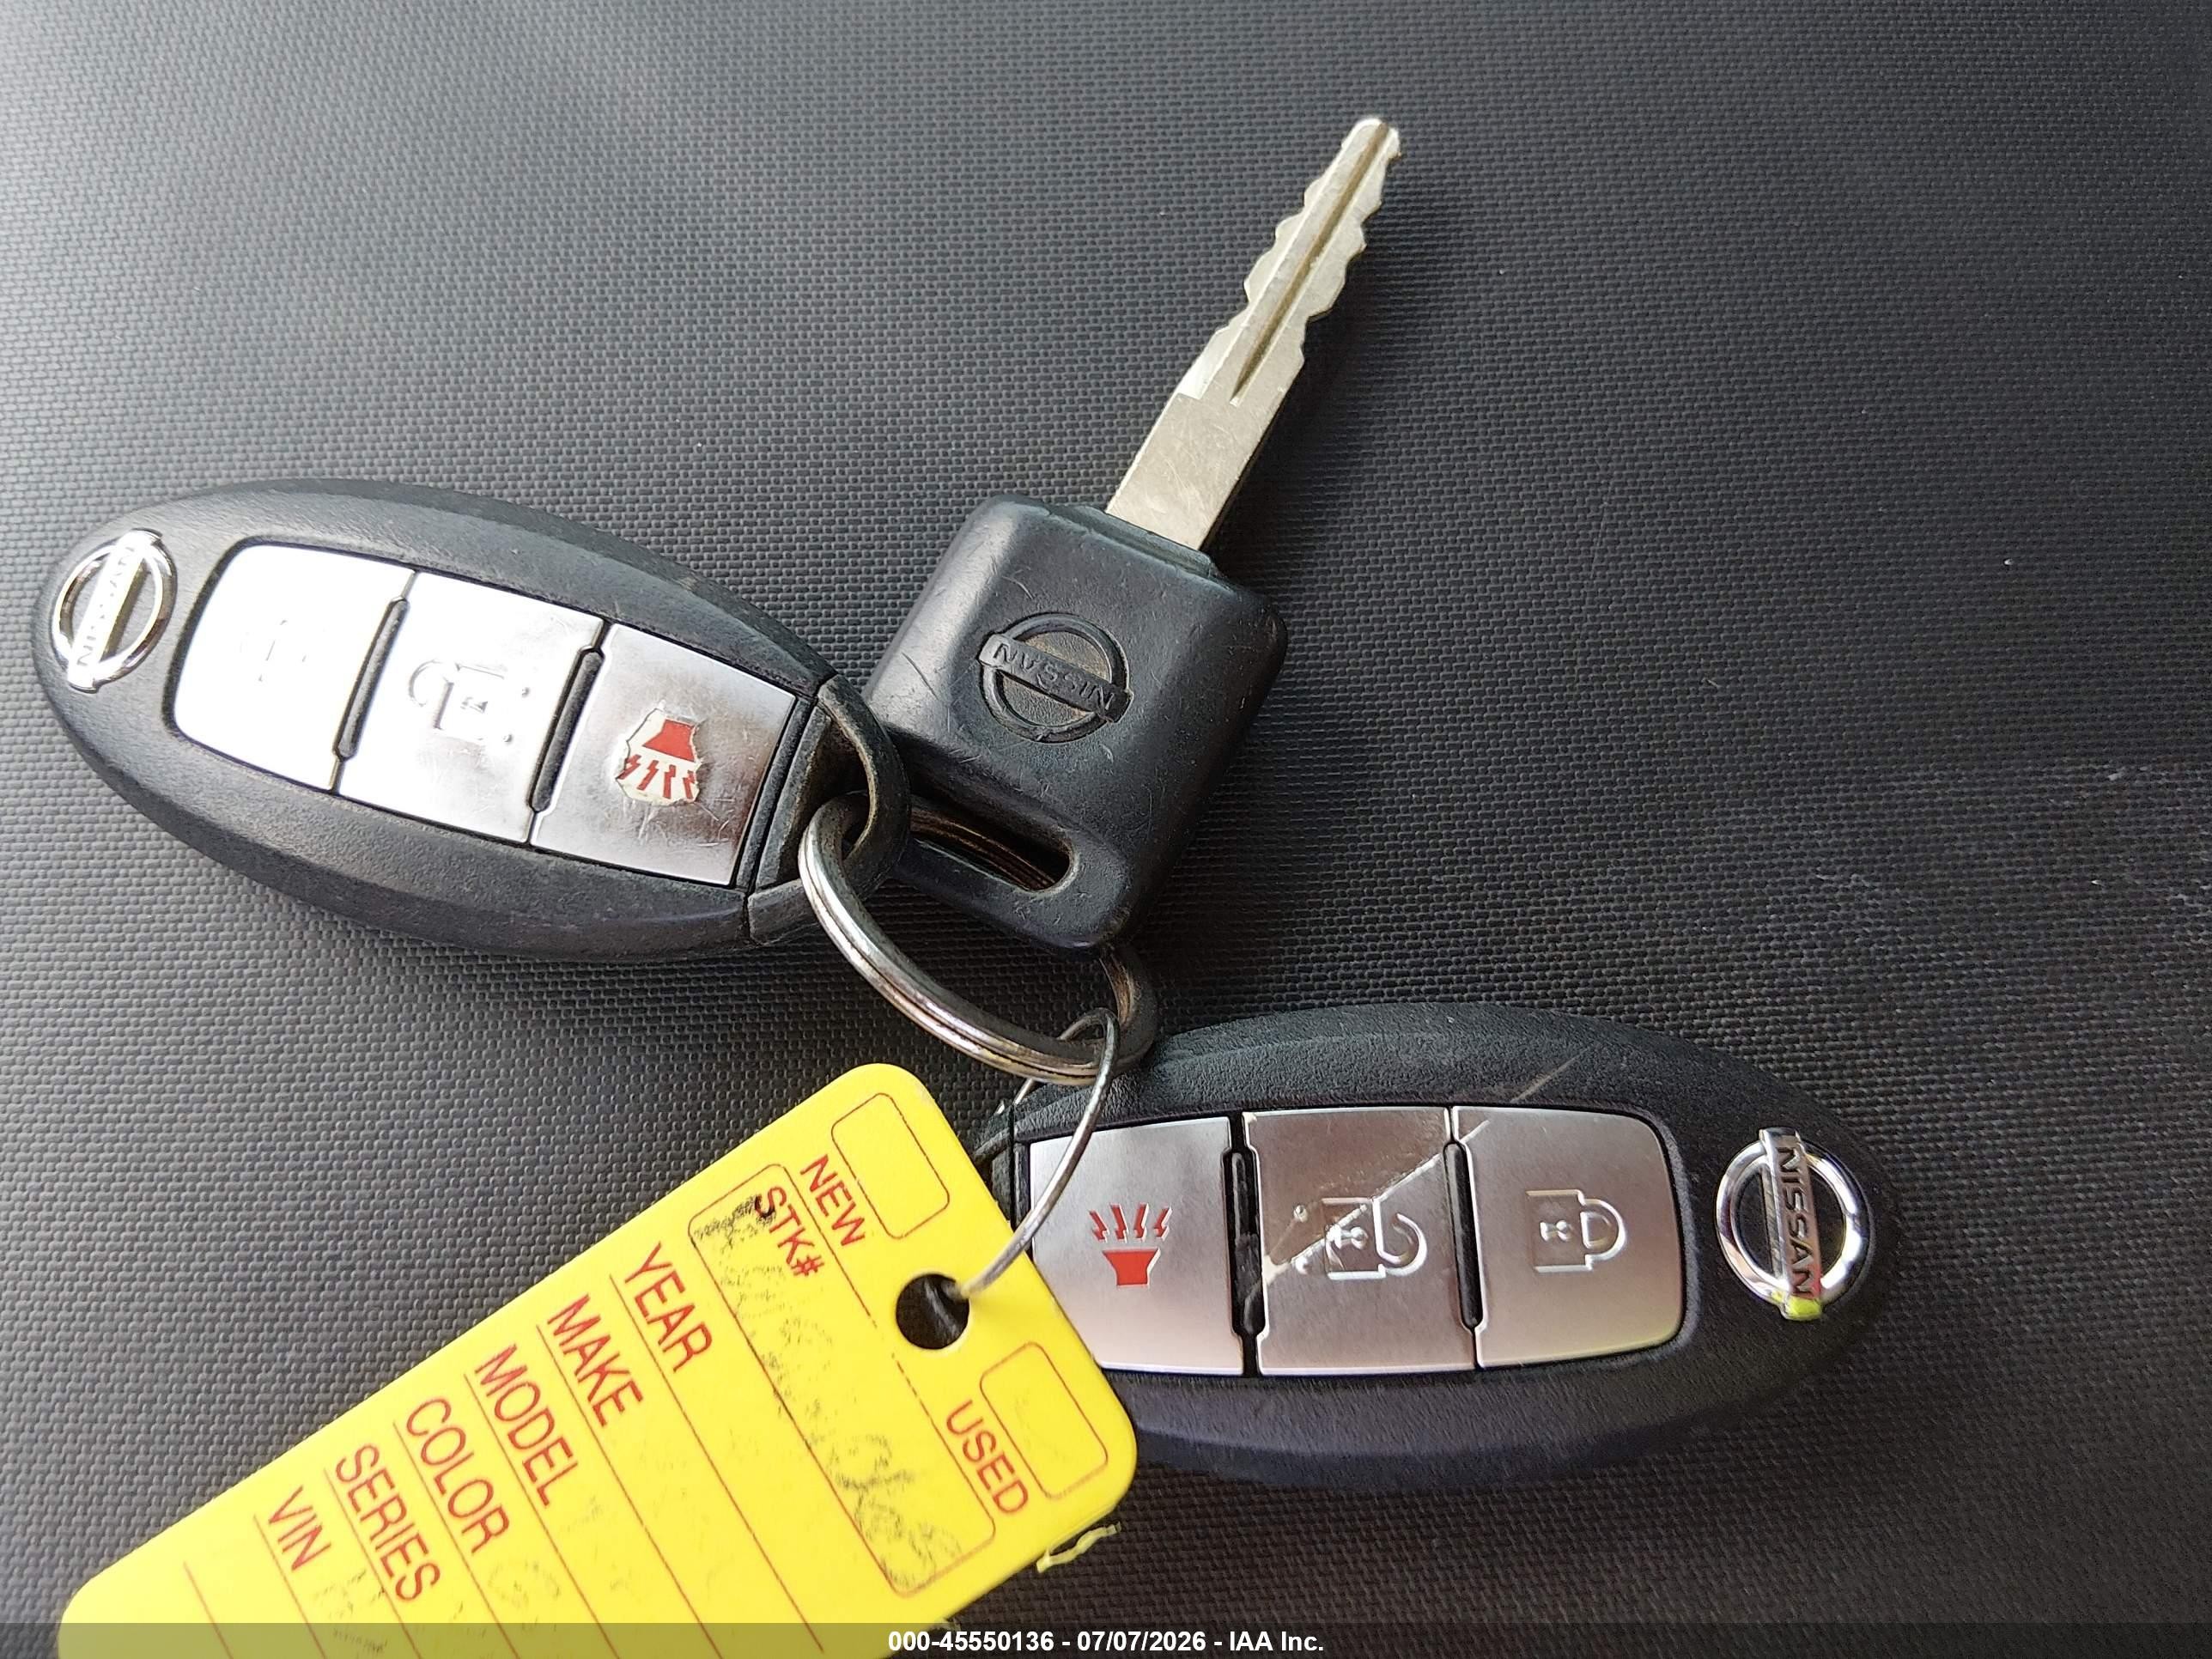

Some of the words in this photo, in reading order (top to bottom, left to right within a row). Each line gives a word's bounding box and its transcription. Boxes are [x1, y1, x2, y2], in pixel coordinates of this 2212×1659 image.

[756, 1184, 825, 1277] STK#
[799, 1153, 866, 1248] NEW
[1776, 1145, 1816, 1300] NISSAN
[547, 1294, 644, 1427] MAKE
[625, 1242, 714, 1373] YEAR
[405, 1397, 510, 1555] COLOR
[474, 1343, 579, 1508] MODEL
[945, 1399, 1030, 1516] USED
[268, 1486, 333, 1572] VIN
[335, 1443, 441, 1603] SERIES
